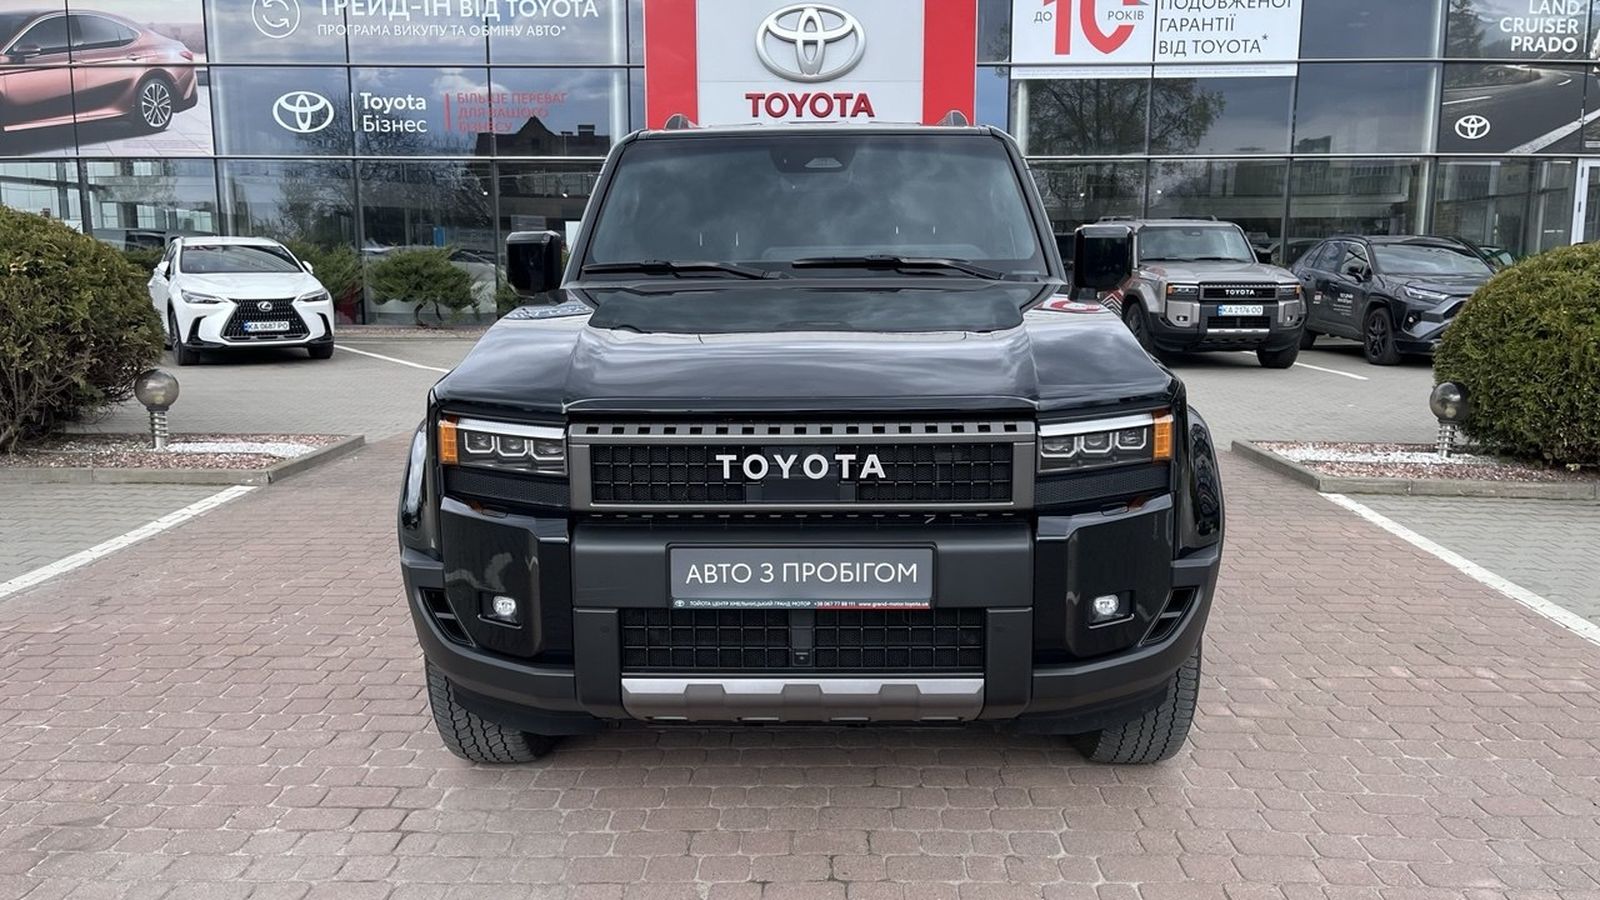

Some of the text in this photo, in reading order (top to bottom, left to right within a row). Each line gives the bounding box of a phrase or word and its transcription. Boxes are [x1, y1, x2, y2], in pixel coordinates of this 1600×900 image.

[460, 0, 500, 22] ВІД
[507, 0, 599, 18] TOYOTA
[1034, 11, 1053, 23] ДО
[1107, 10, 1145, 21] РОКІВ
[1529, 0, 1580, 15] LAND
[317, 24, 390, 36] ПРОГРАМА
[394, 24, 447, 36] ВИКУПУ
[450, 24, 466, 36] ТА
[469, 24, 523, 37] ОБМІНУ
[1159, 13, 1236, 32] ГАРАНТІЇ
[1500, 16, 1579, 34] CRUISER
[1159, 40, 1187, 57] ВІД
[1510, 35, 1578, 53] PRADO
[360, 92, 427, 113] Toyota
[745, 92, 875, 118] TOYOTA
[363, 115, 427, 132] Бізнес
[715, 454, 886, 480] TOYOTA
[686, 562, 917, 584] АВТО З ПРОБІГОМ
